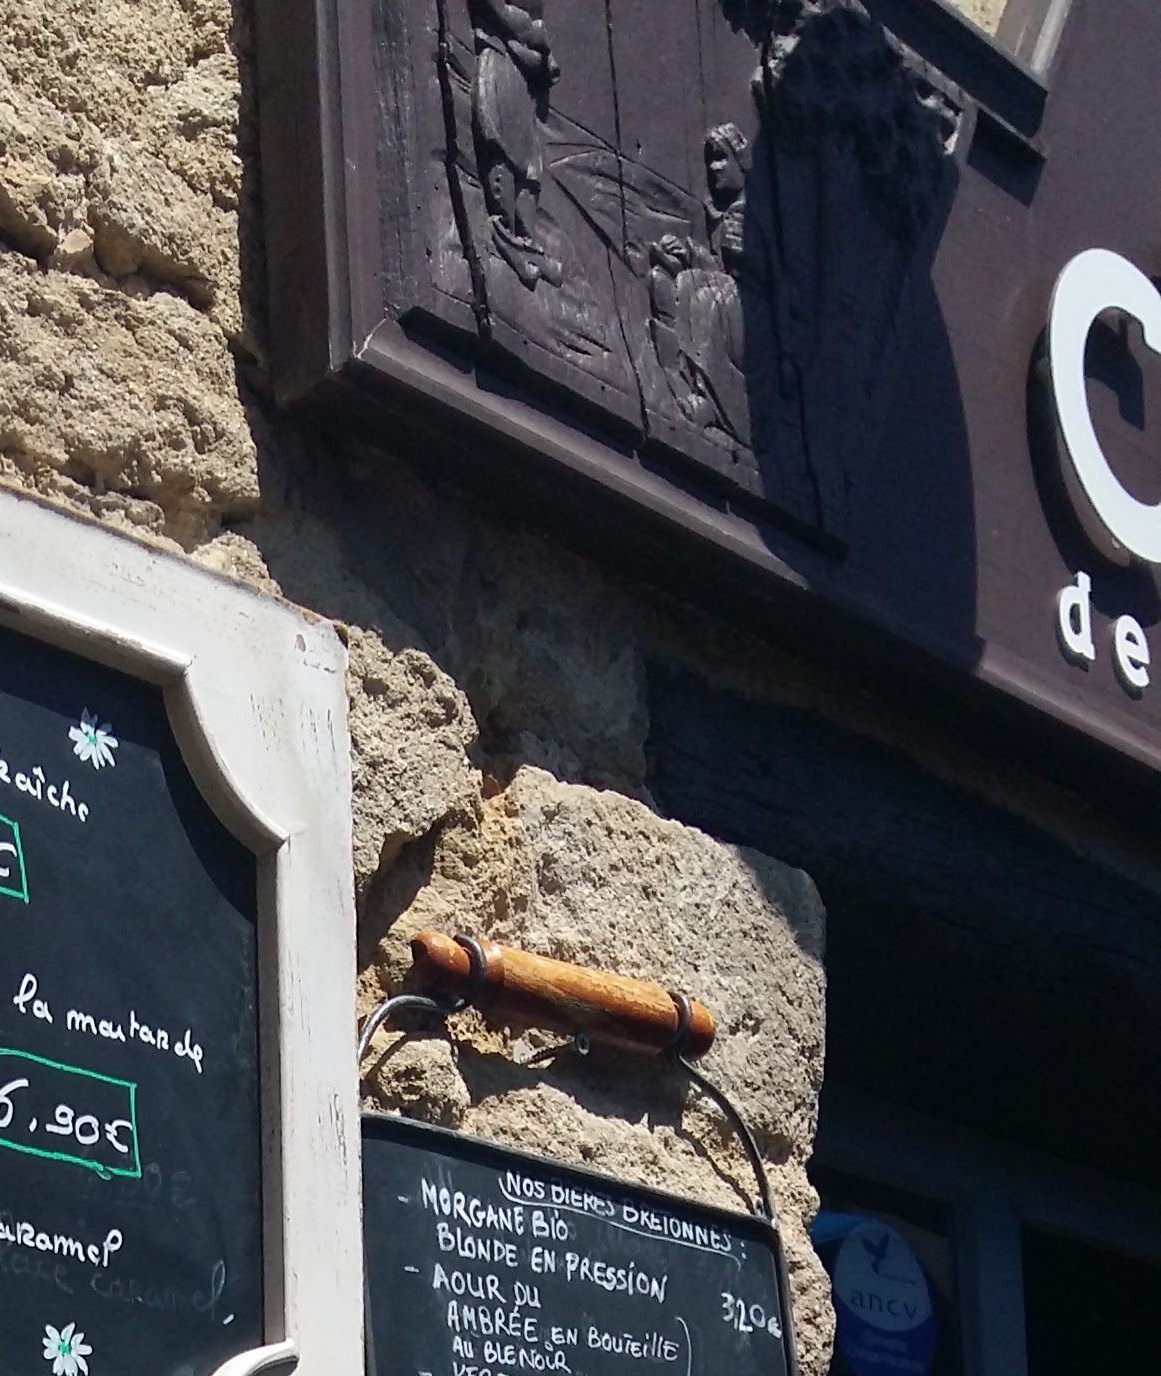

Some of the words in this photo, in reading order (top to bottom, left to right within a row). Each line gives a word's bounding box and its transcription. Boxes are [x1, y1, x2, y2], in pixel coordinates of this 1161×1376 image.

[1056, 570, 1151, 690] de
[14, 973, 54, 1026] la
[504, 1170, 547, 1201] NOS
[420, 1177, 525, 1236] MORGANE
[435, 1221, 519, 1268] BLONDE
[530, 1245, 557, 1274] EN
[564, 1252, 669, 1304] PRESSION
[513, 1280, 542, 1309] DU
[849, 1288, 918, 1322] ancv
[451, 1334, 476, 1360] AU
[550, 1326, 579, 1347] EN
